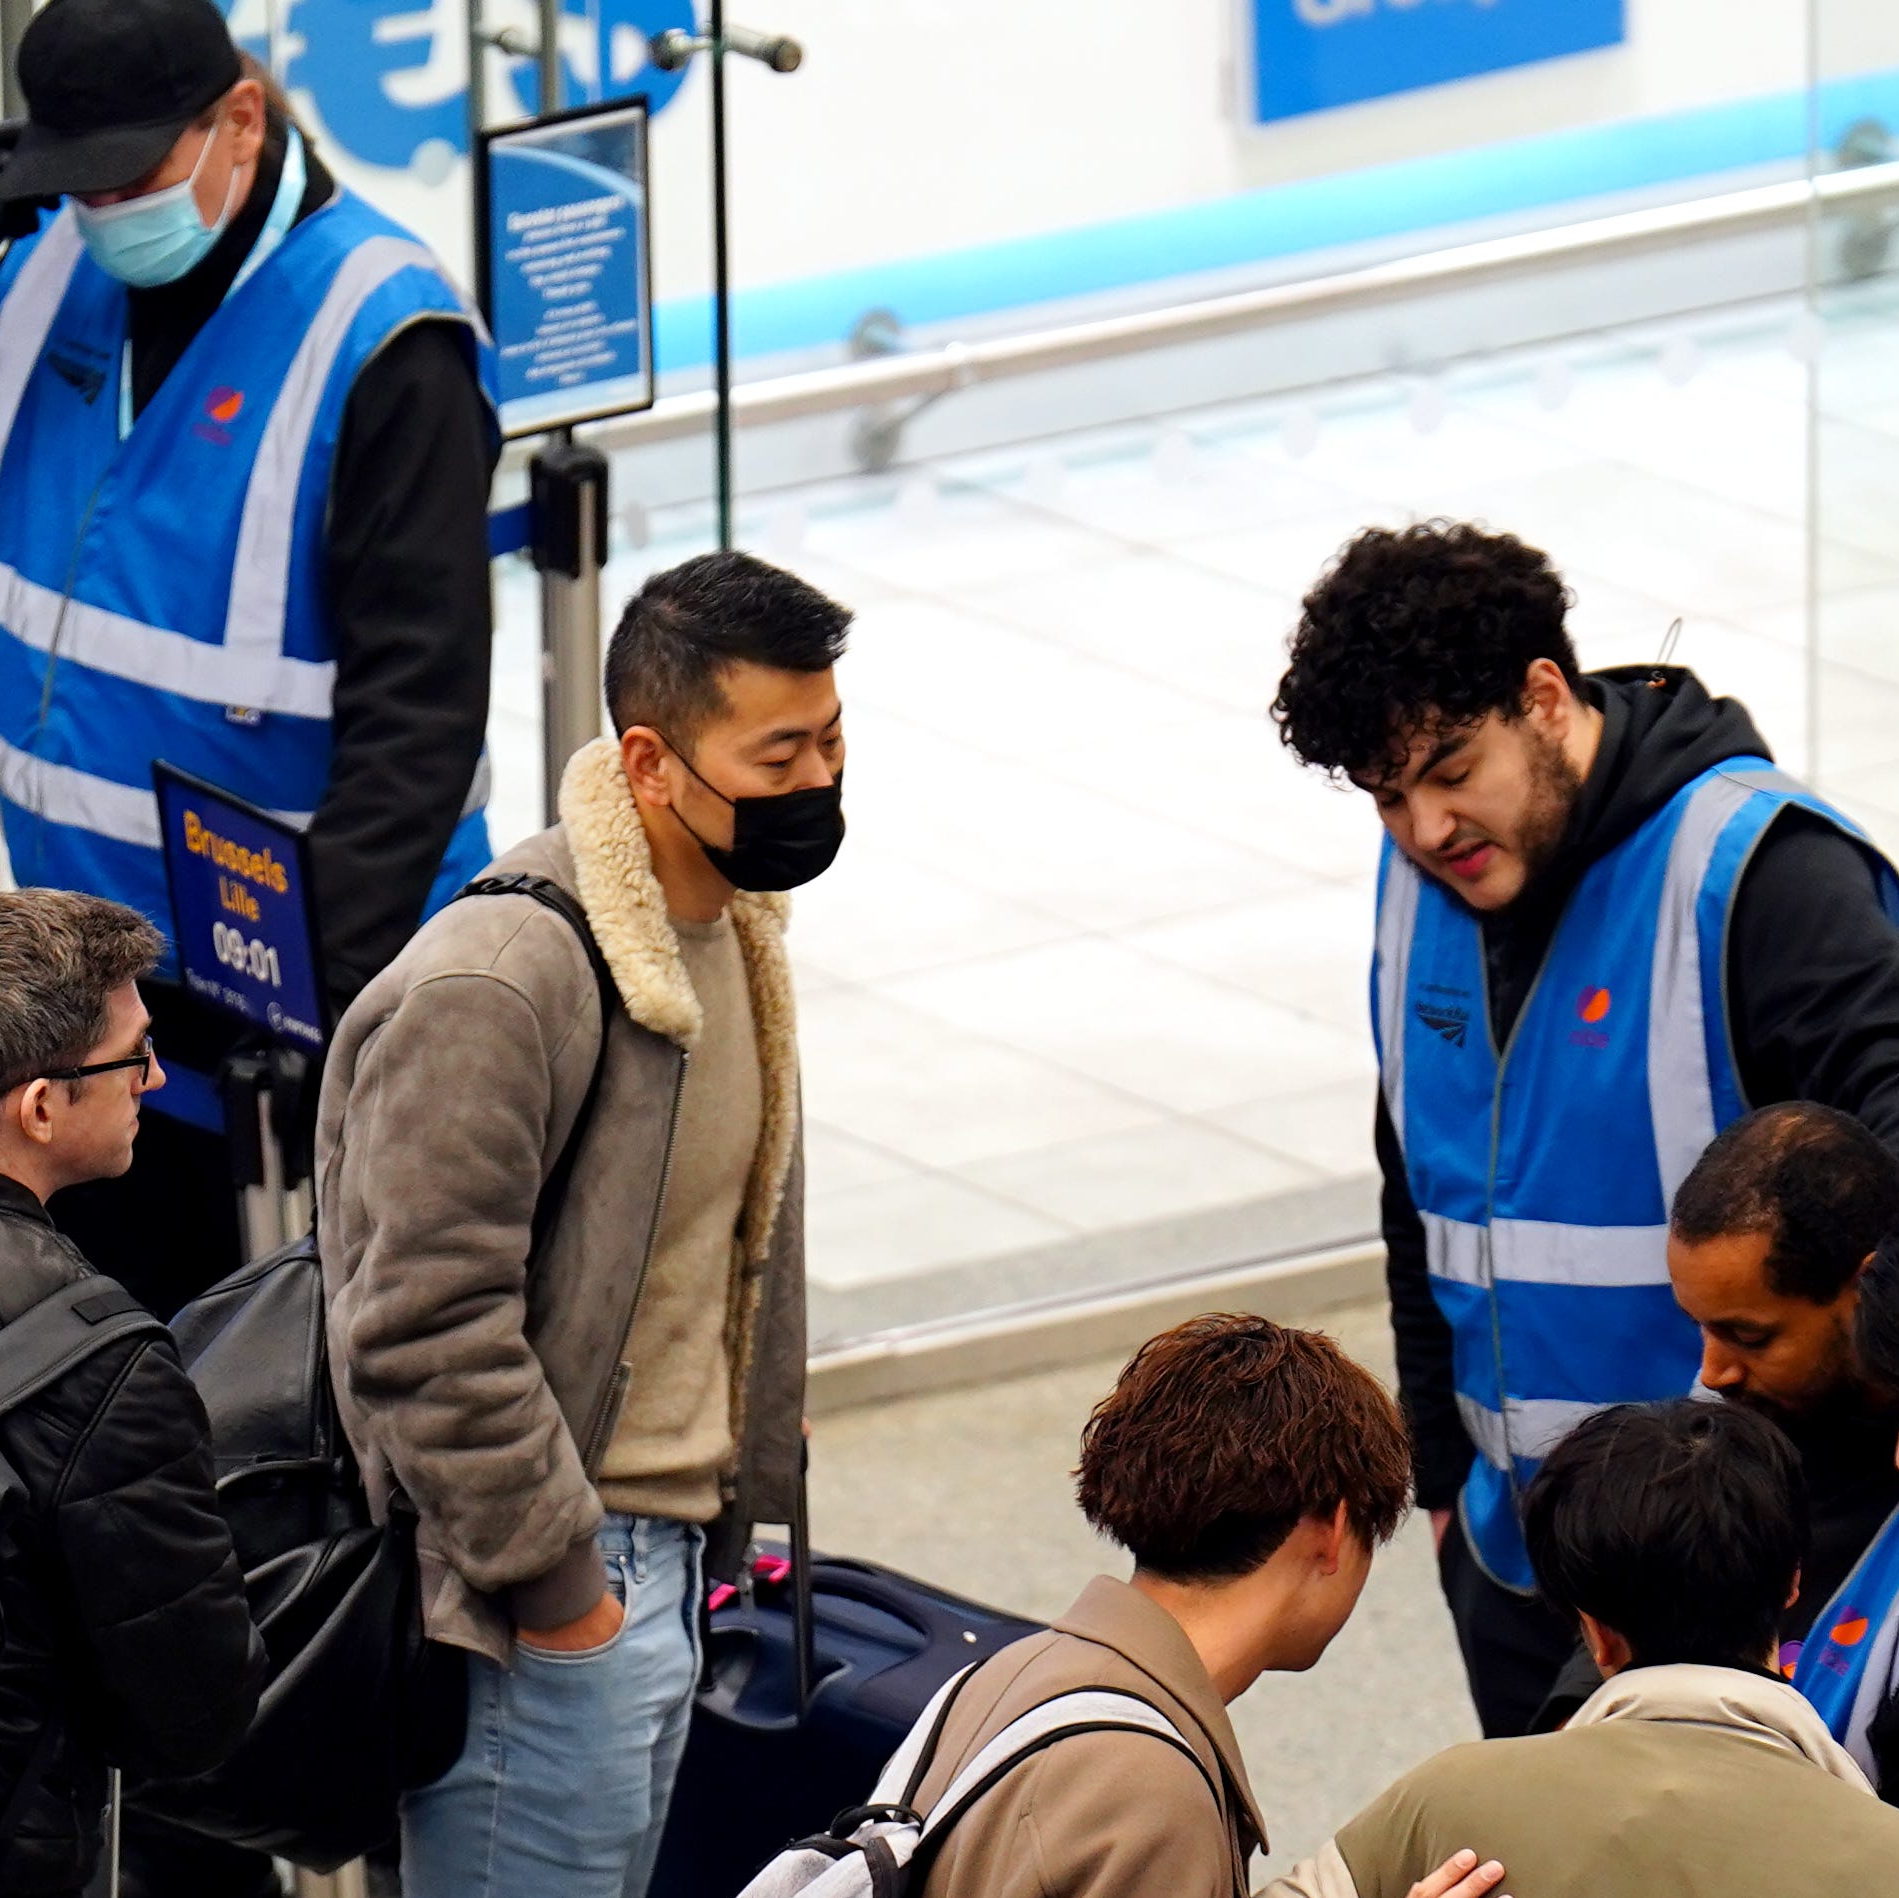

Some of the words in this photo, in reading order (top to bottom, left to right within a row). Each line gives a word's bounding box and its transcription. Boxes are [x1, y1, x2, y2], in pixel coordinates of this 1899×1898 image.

[183, 809, 289, 894] Brussels
[219, 875, 260, 922] Lille
[212, 920, 282, 988] 09:01
